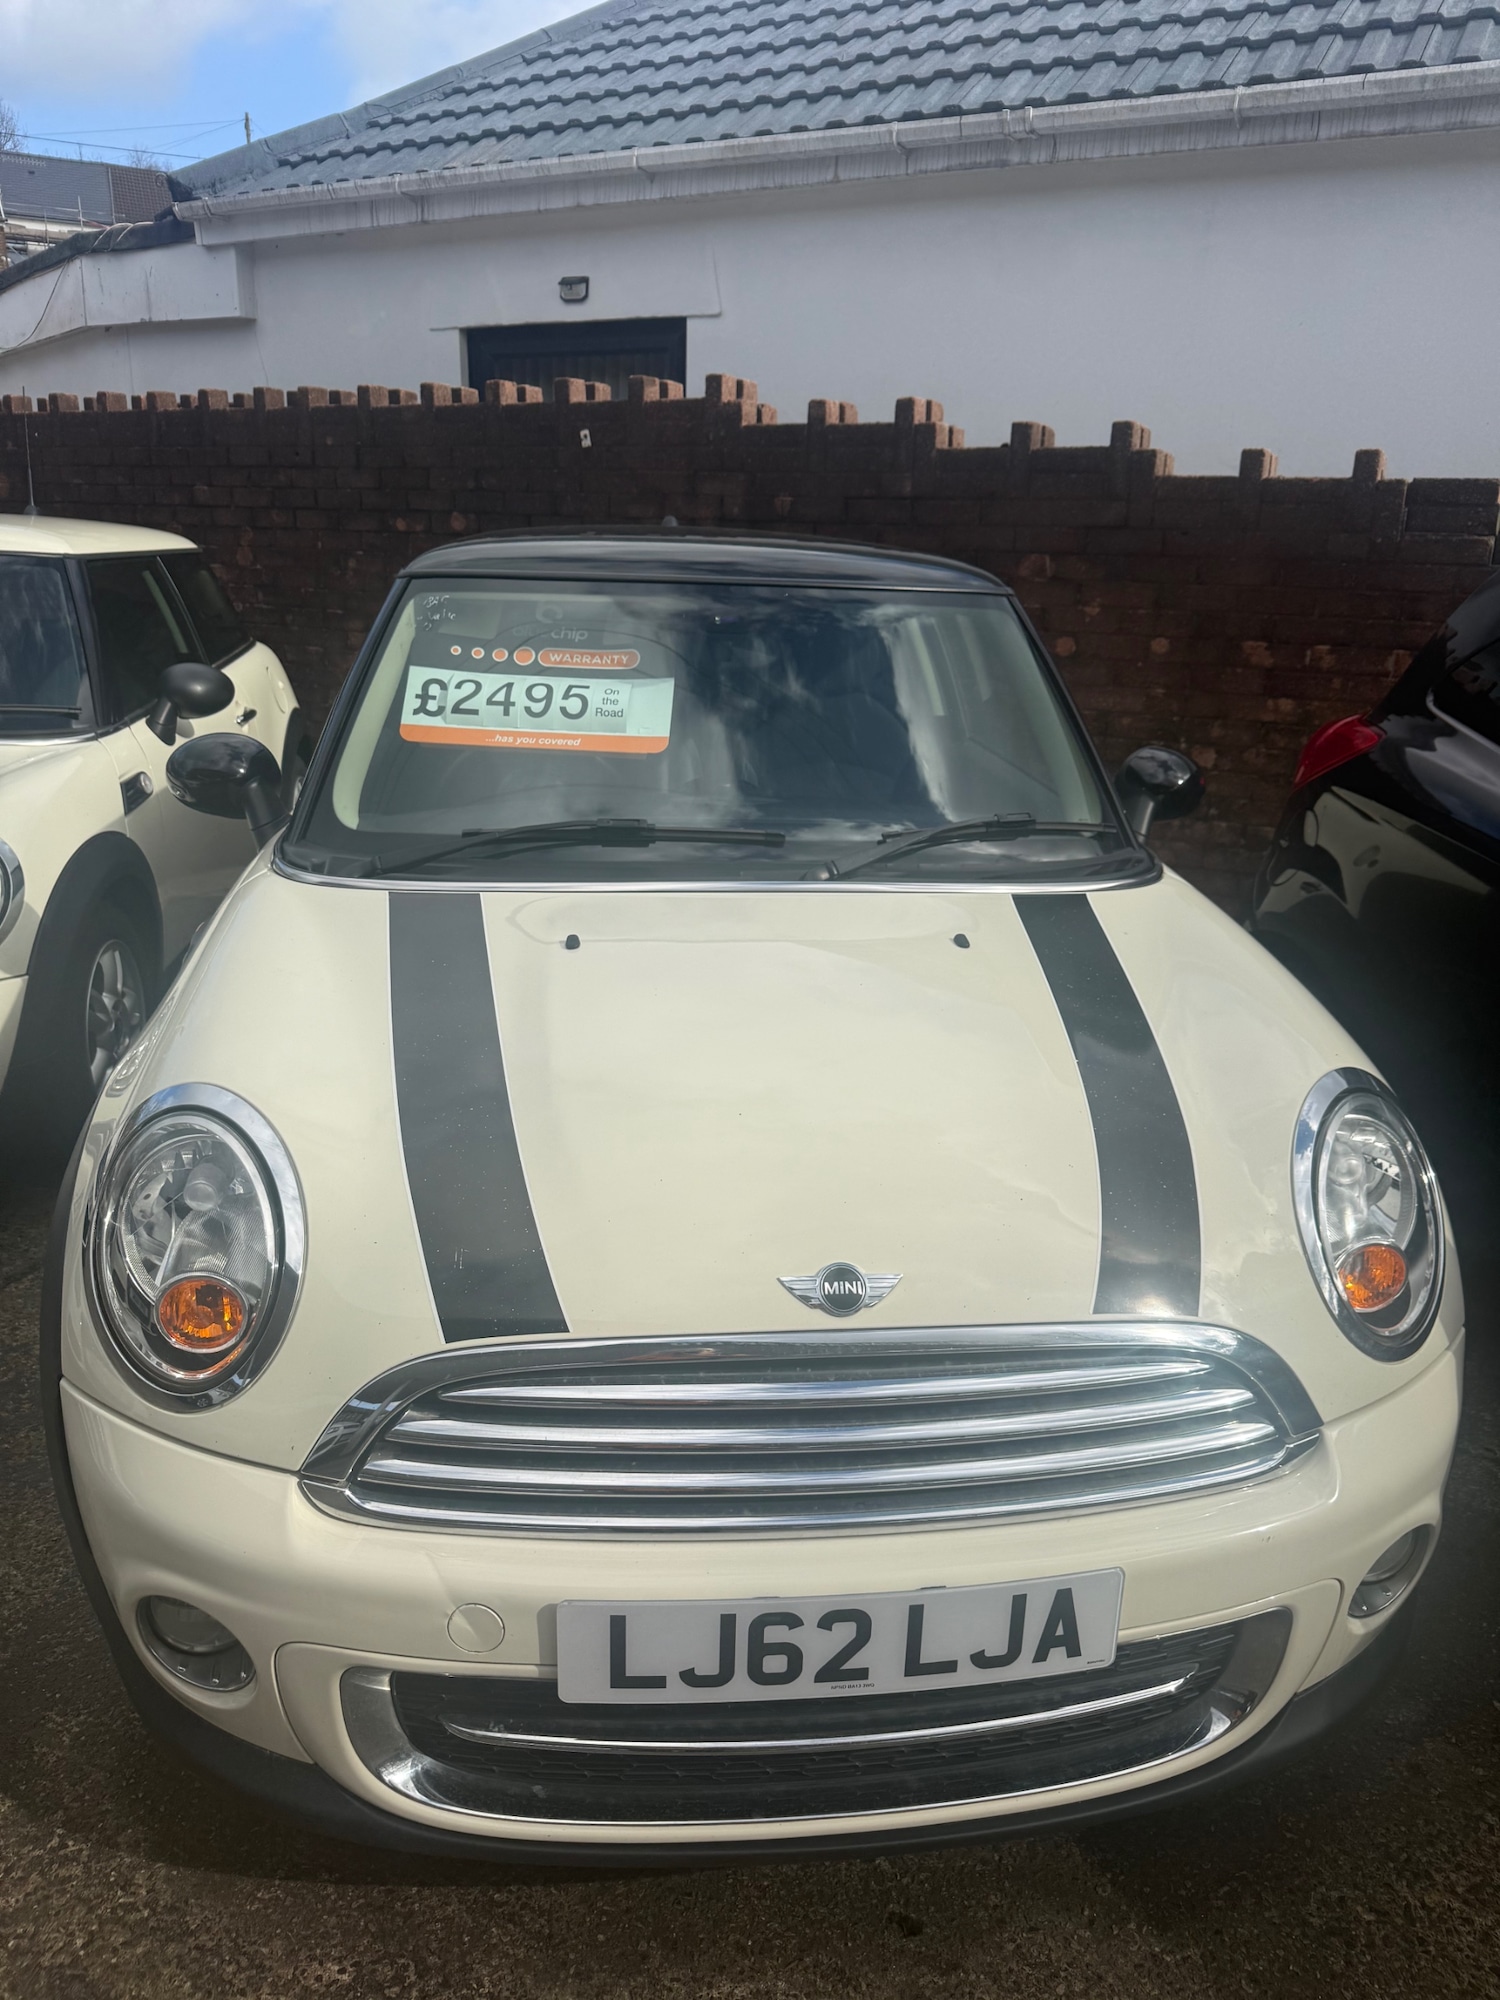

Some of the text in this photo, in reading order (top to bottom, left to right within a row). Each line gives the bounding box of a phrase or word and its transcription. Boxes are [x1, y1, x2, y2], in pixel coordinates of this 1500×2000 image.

[549, 652, 629, 665] WARRANTY
[604, 688, 620, 696] On
[412, 678, 591, 721] £2495
[602, 697, 619, 706] the
[595, 707, 624, 718] Road
[516, 736, 536, 746] you
[538, 737, 581, 747] covered
[823, 1280, 863, 1295] MINI
[609, 1587, 1082, 1689] LJ62 LJA
